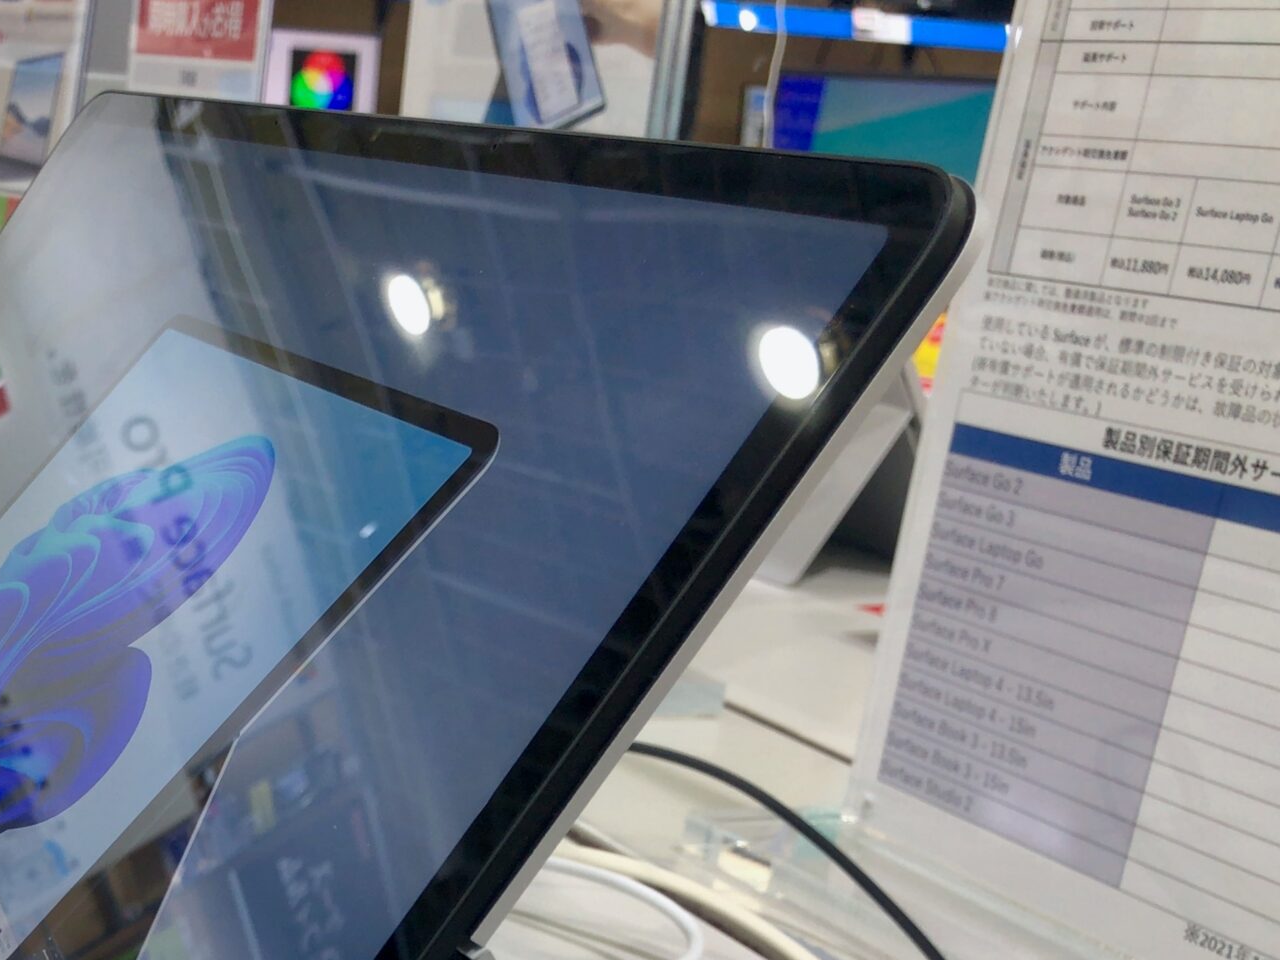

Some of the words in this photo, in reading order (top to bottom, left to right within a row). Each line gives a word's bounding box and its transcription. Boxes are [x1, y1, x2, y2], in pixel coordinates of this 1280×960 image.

[1195, 205, 1228, 220] Surface
[1229, 209, 1260, 225] Laptop
[1052, 326, 1092, 347] Surface
[943, 458, 990, 487] Surface
[1059, 451, 1093, 481] 製品
